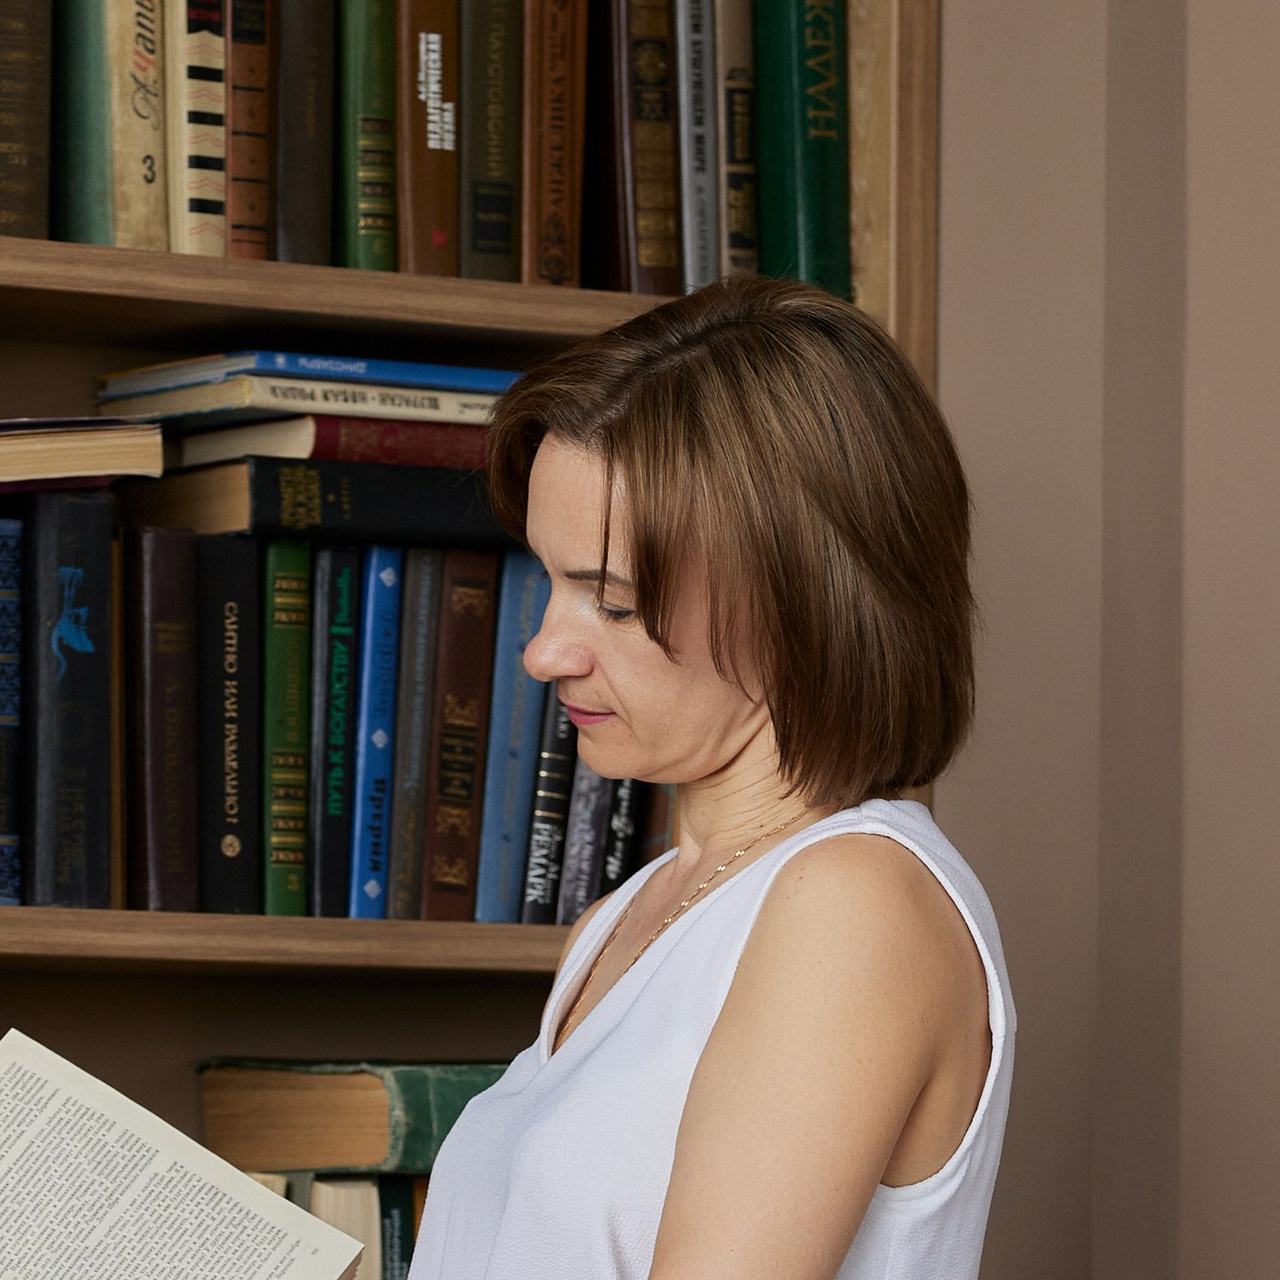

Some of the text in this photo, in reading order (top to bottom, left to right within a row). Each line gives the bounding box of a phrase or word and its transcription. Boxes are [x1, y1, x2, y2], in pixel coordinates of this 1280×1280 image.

[141, 154, 157, 186] 3
[223, 679, 238, 718] ИЛИ
[327, 639, 351, 816] ПУТЬ К БОГАТСТВУ
